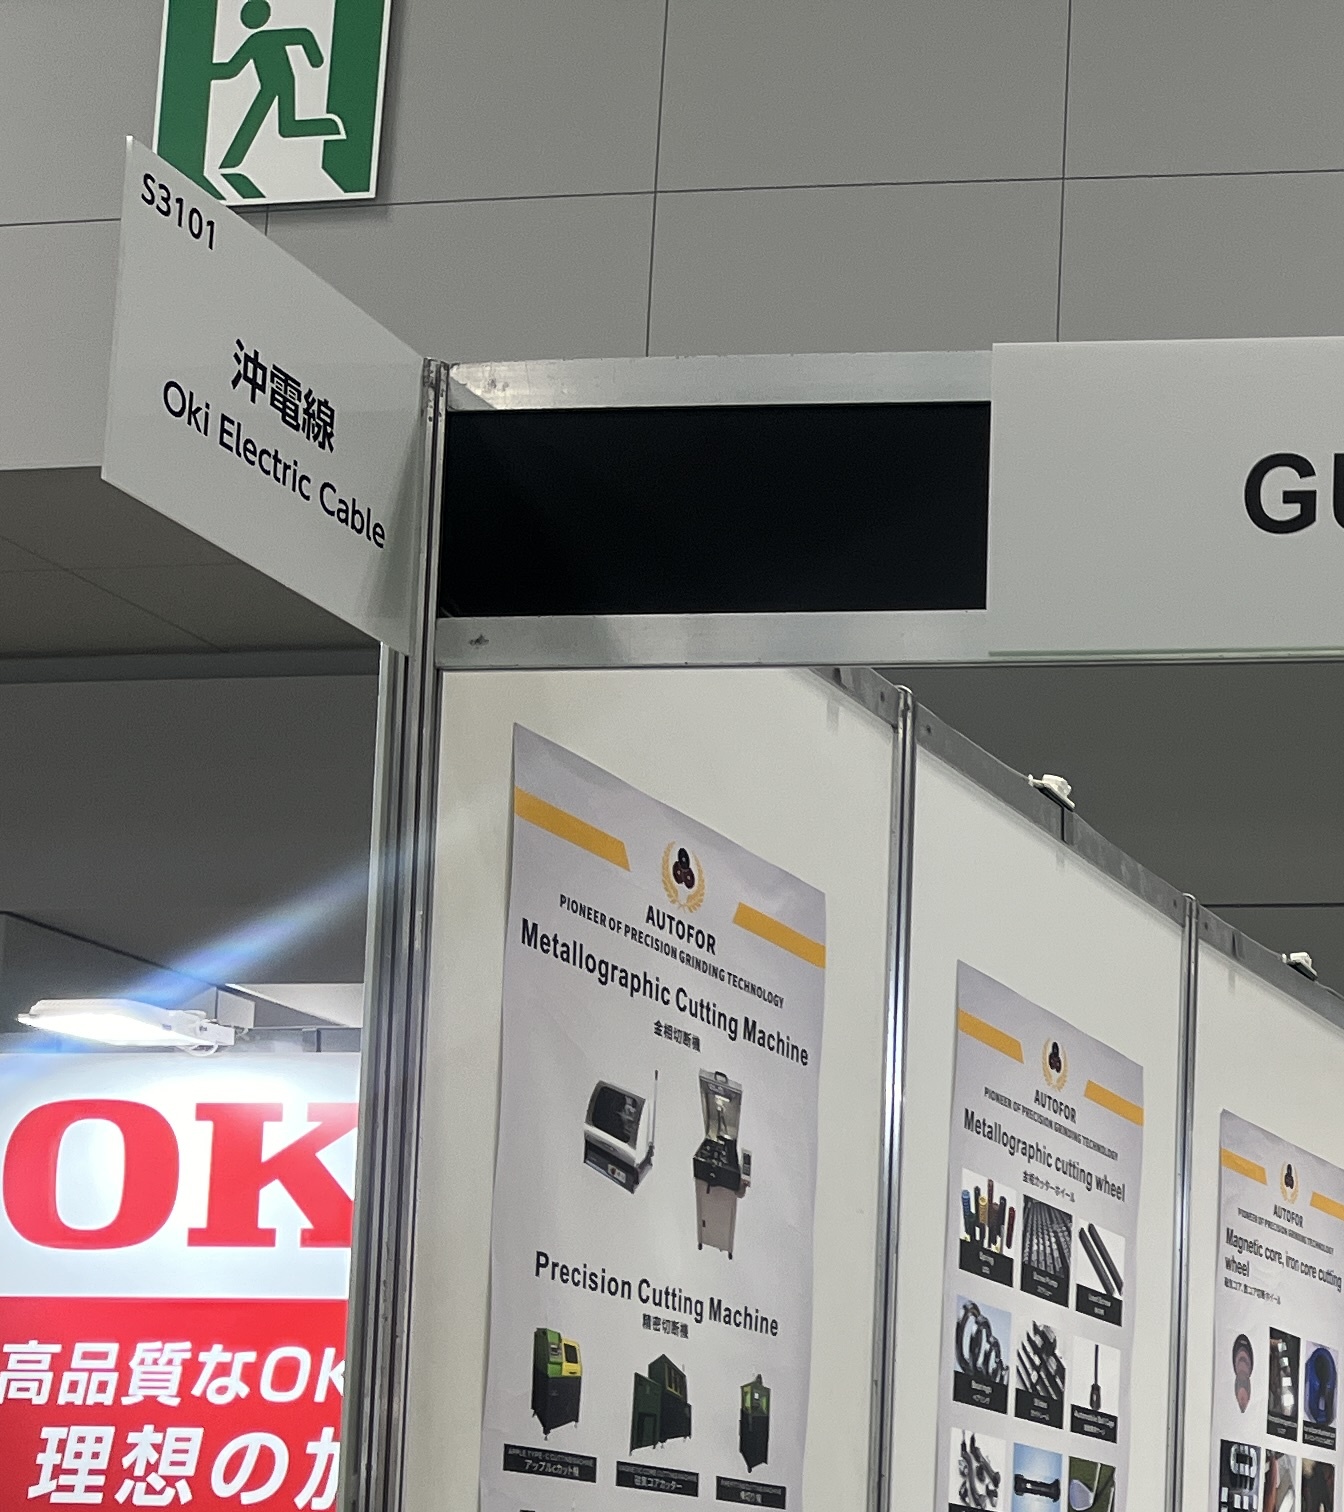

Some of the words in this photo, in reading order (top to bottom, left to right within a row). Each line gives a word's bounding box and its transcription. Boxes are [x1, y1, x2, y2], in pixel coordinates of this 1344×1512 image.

[141, 173, 217, 251] S3101
[231, 338, 335, 453] 沖電線
[163, 381, 210, 436] Oki
[219, 415, 311, 502] Electric
[320, 482, 386, 549] Cable
[559, 893, 607, 928] PIONEER
[608, 917, 622, 934] OF
[624, 924, 678, 960] PRECISION
[679, 951, 726, 982] GRINDING
[727, 971, 785, 1009] TECHNOLOGY
[645, 905, 716, 955] AUTOFOR
[520, 917, 671, 1006] Metallographic
[675, 987, 738, 1042] Cutting
[742, 1015, 809, 1067] Machine
[1033, 1089, 1077, 1125] AUTOFOR
[964, 1107, 1053, 1168] Metallographic
[1055, 1156, 1093, 1192] cutting
[1095, 1173, 1126, 1202] wheel
[1226, 1227, 1263, 1258] Magnetic
[1300, 1261, 1317, 1279] core
[1273, 1204, 1303, 1229] AUTOFOR
[534, 1250, 632, 1301] Precision
[637, 1277, 704, 1324] Cutting
[708, 1296, 779, 1338] Machine
[1224, 1254, 1250, 1277] wheel
